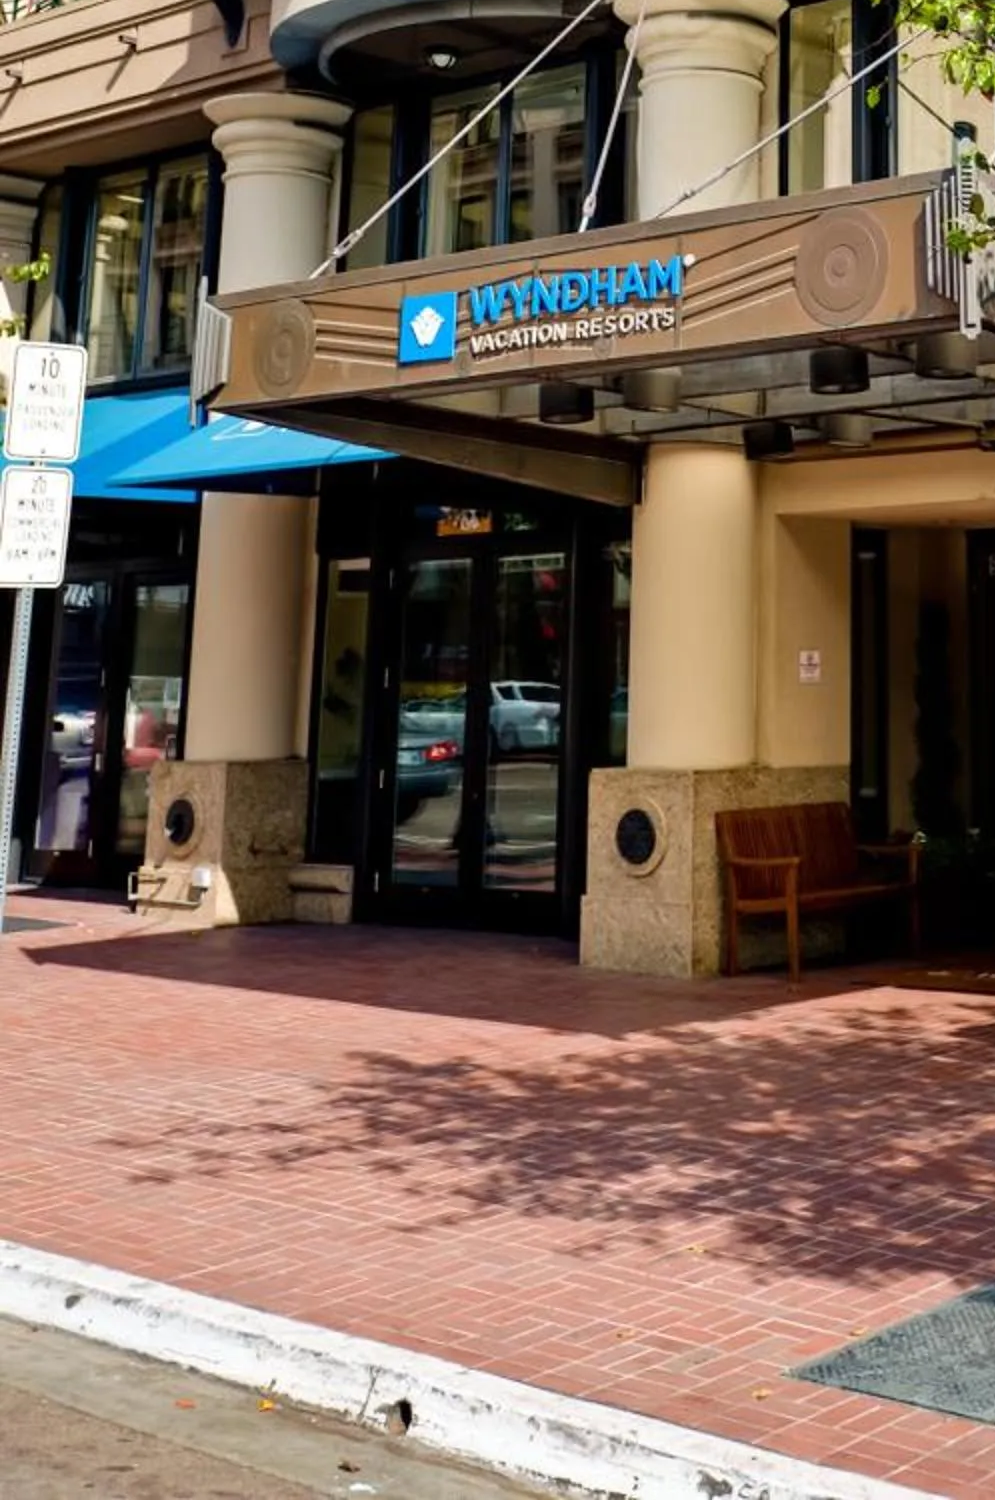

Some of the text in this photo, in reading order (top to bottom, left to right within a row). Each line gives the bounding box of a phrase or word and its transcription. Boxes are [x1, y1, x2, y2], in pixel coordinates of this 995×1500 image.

[468, 254, 683, 326] WYNDHAM
[470, 307, 676, 355] VACATION RESORTS
[41, 357, 61, 379] 10
